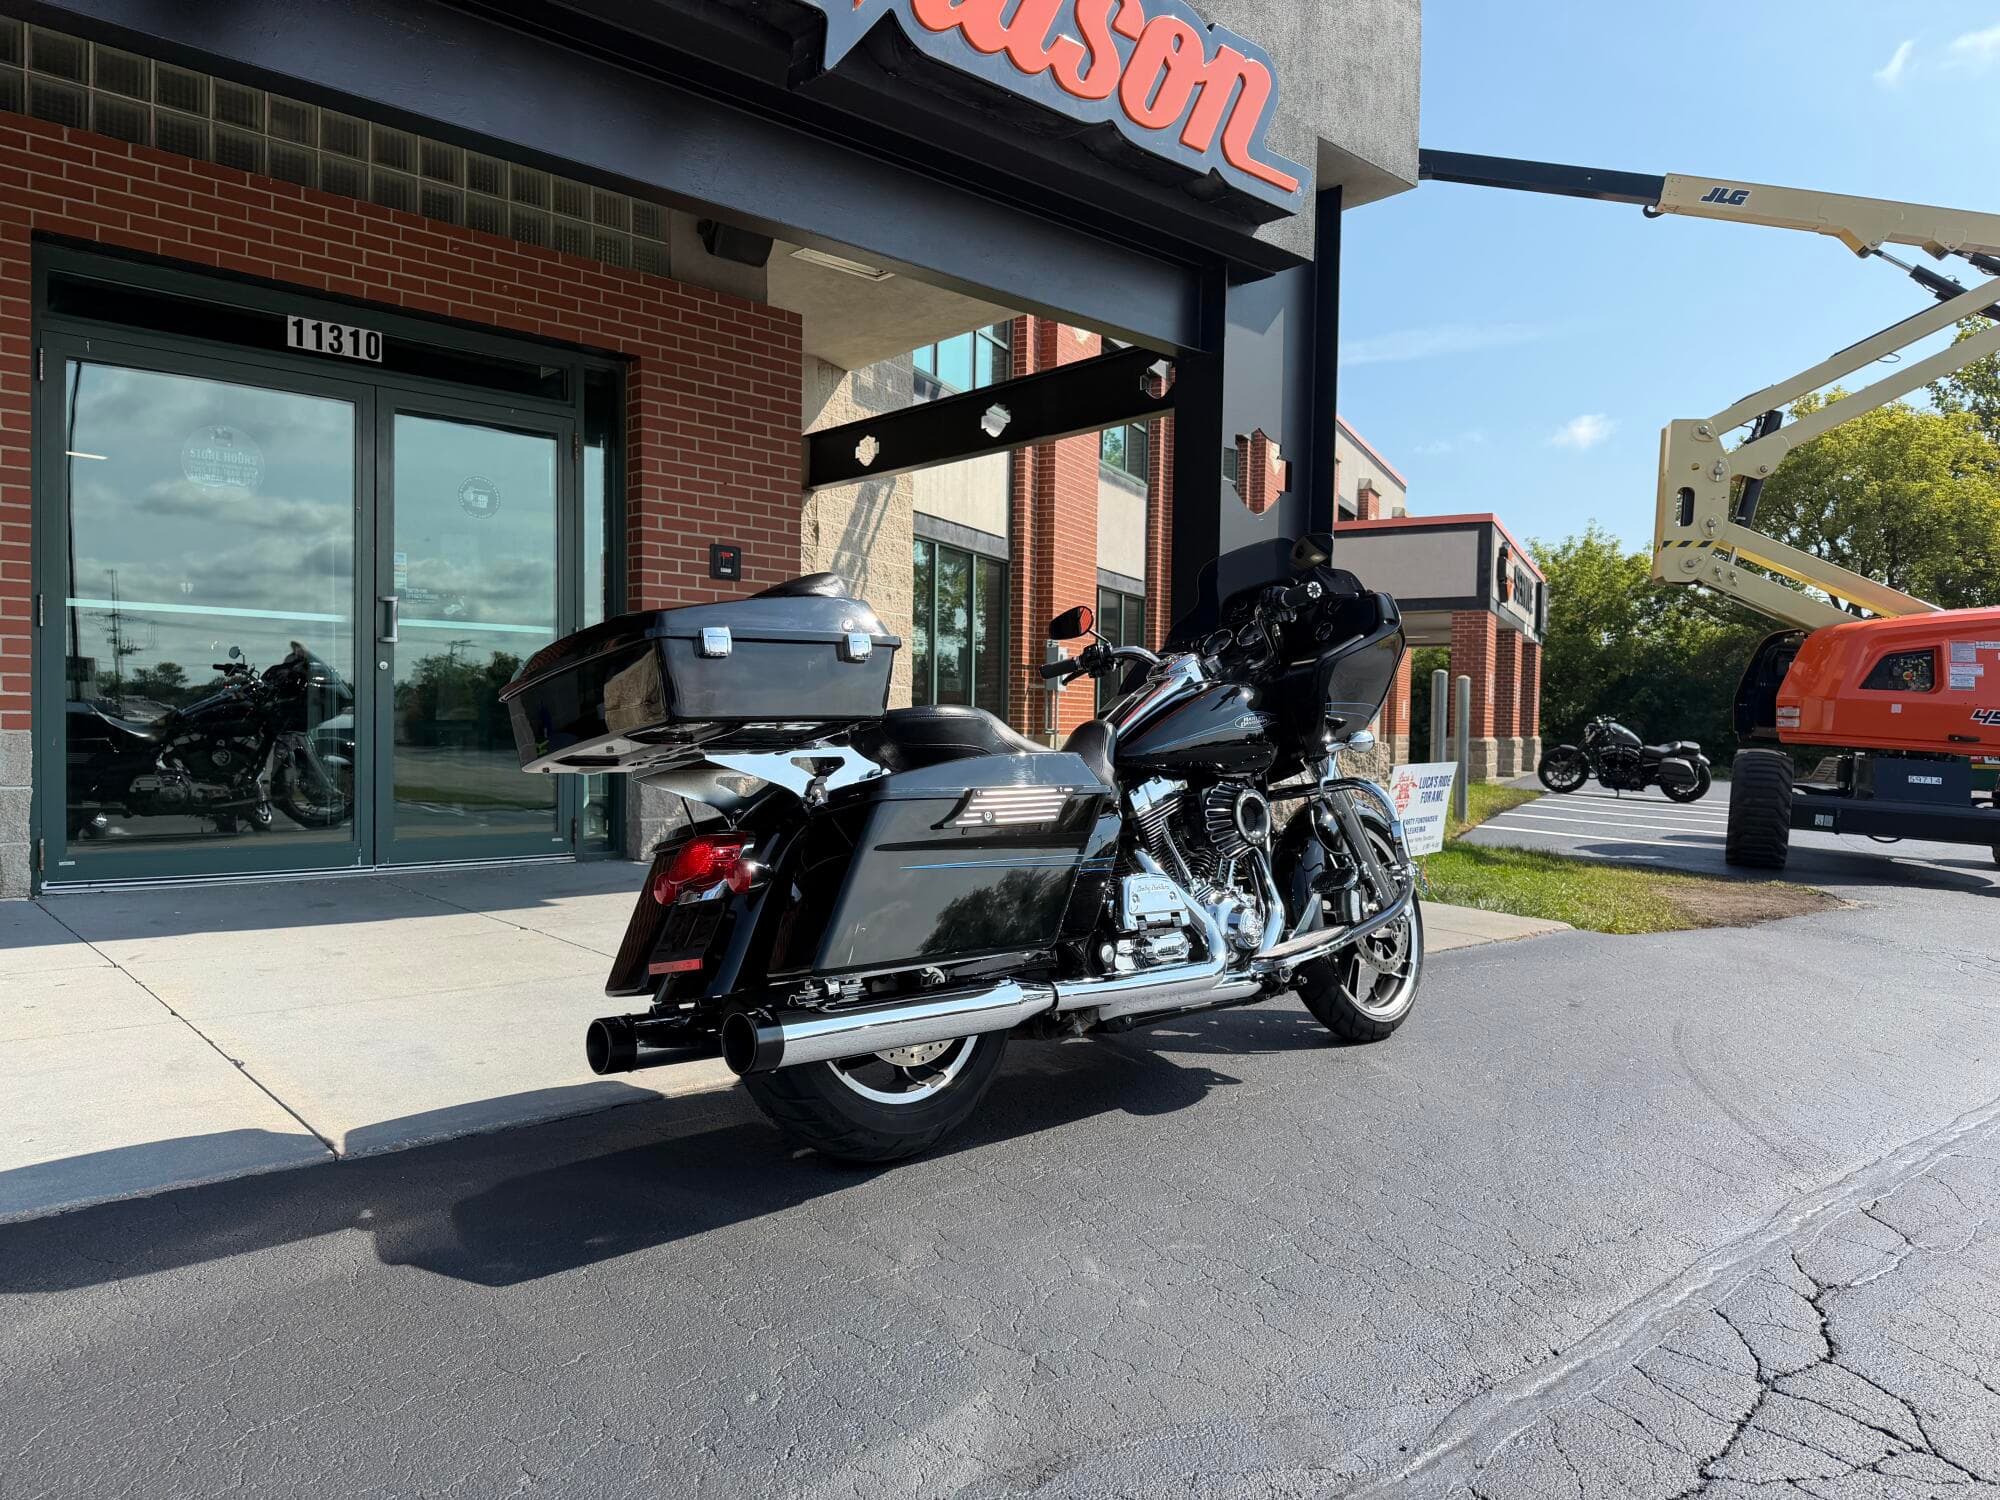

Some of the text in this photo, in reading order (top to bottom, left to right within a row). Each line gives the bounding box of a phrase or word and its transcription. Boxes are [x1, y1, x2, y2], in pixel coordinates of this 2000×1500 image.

[1700, 187, 1750, 206] JLG
[292, 318, 380, 360] 11310
[1419, 774, 1452, 789] LUCA'S RIDE
[1421, 791, 1432, 803] FOR
